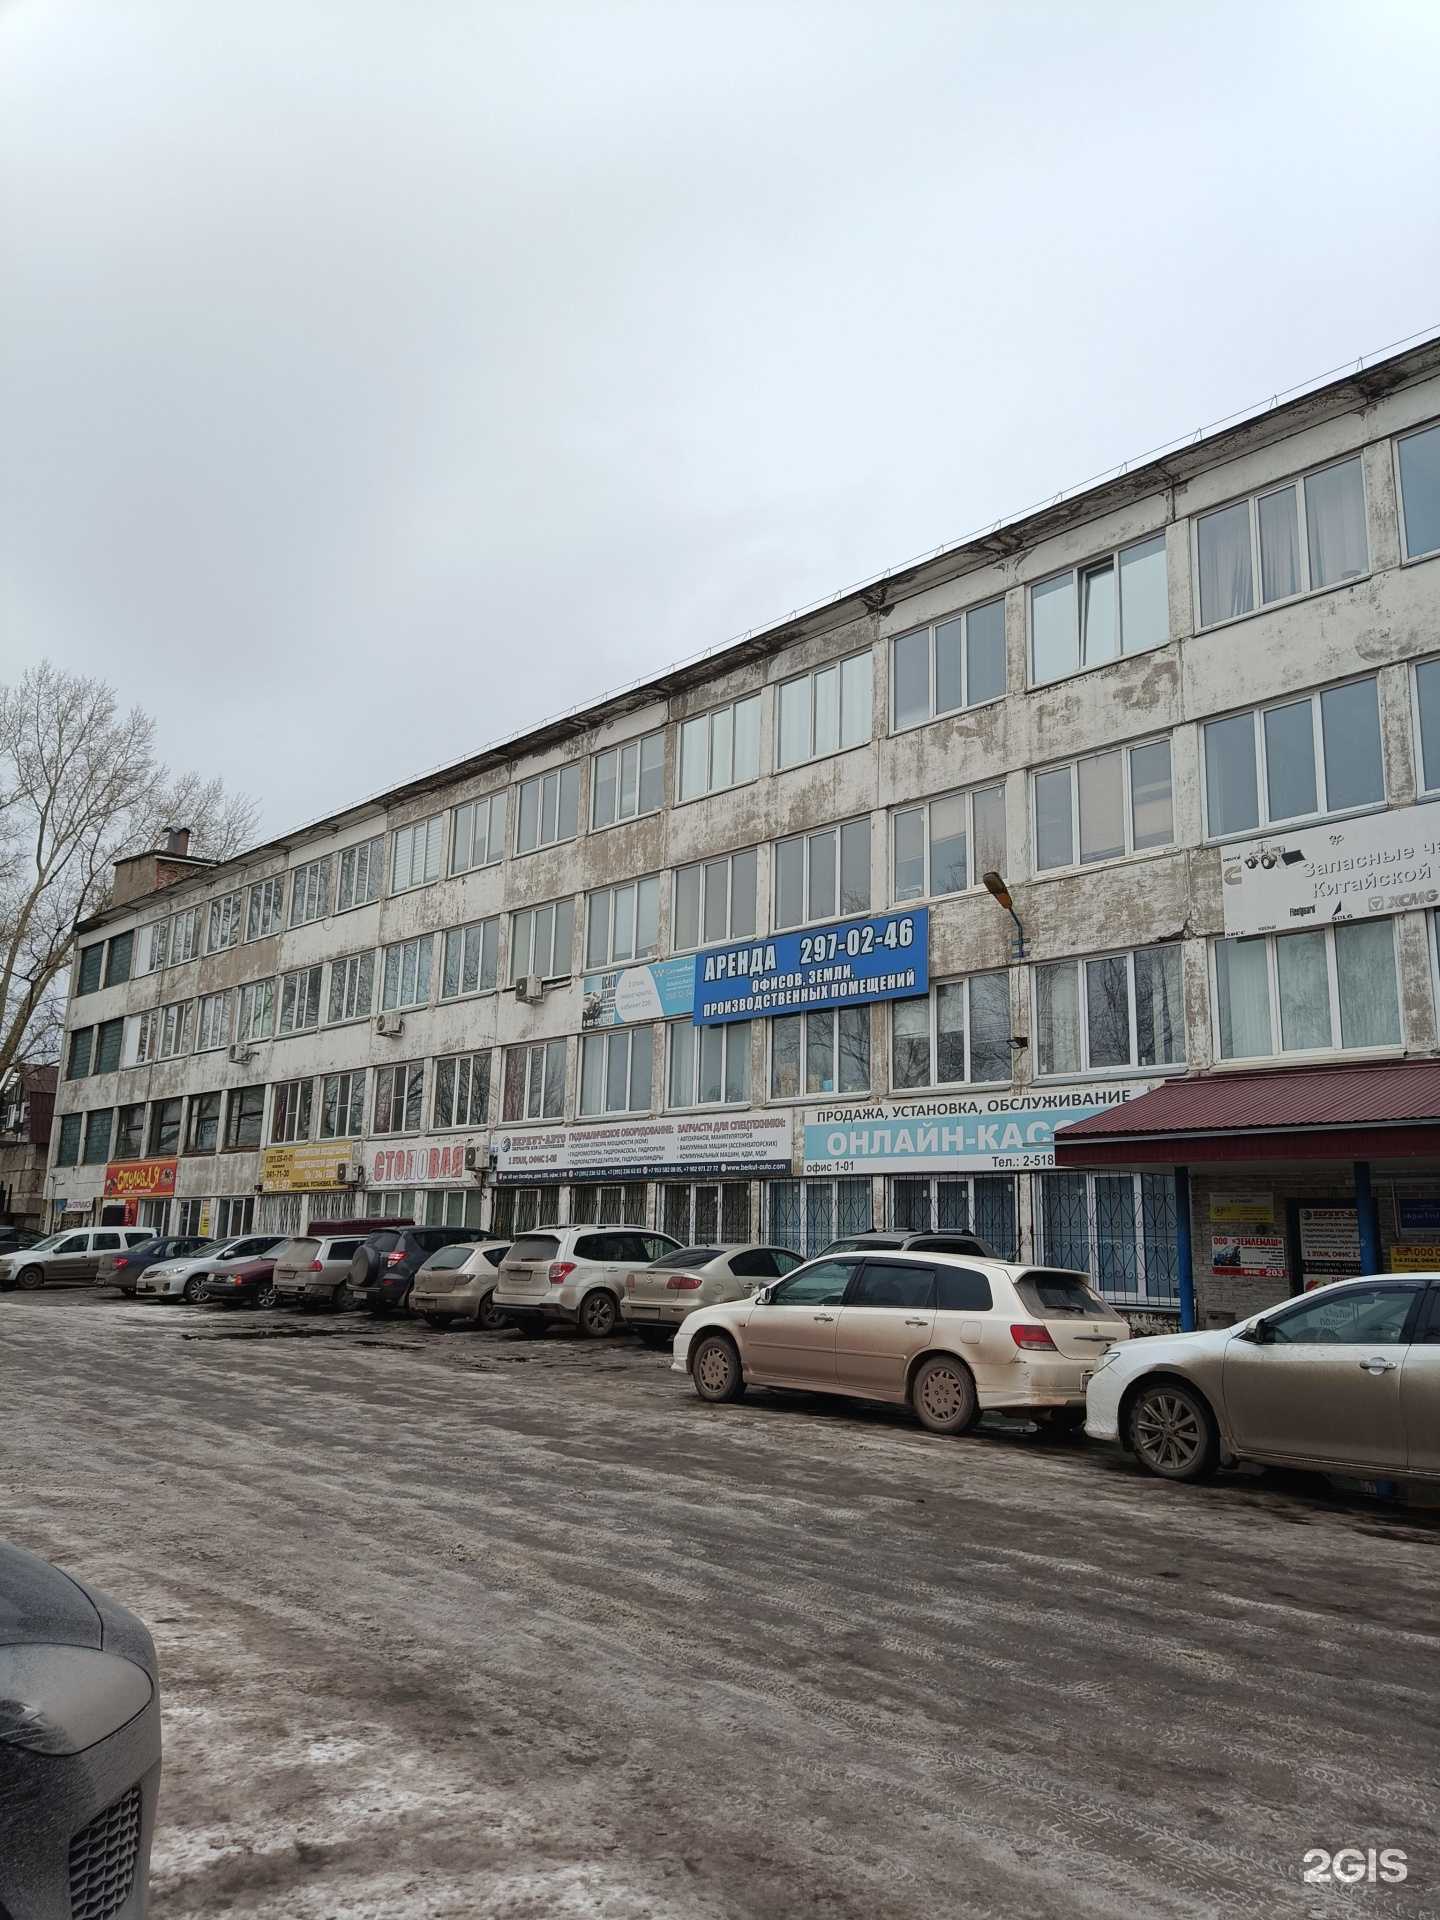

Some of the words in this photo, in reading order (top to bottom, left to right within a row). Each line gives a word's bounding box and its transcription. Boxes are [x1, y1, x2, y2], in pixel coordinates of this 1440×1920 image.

[1303, 847, 1415, 878] Запасные
[1314, 863, 1431, 898] Китайской
[1386, 889, 1439, 908] XCMG
[704, 945, 776, 982] АРЕНДА
[800, 918, 913, 964] 297-02-46
[704, 987, 828, 1017] ПРОИЗВОДСТВЕННЫХ
[831, 968, 915, 998] ПОМЕЩЕНИЙ
[752, 971, 806, 993] ОФИСОВ,
[808, 964, 854, 984] ЗЕМЛИ,
[817, 1107, 888, 1124] ПРОДАЖА,
[892, 1102, 982, 1119] УСТАНОВКА,
[987, 1090, 1131, 1112] ОБСЛУЖИВАНИЕ
[374, 1146, 464, 1182] СТОЛОВАЯ
[806, 1162, 832, 1174] офис
[835, 1161, 854, 1171] 1-01
[1266, 1269, 1284, 1277] 203
